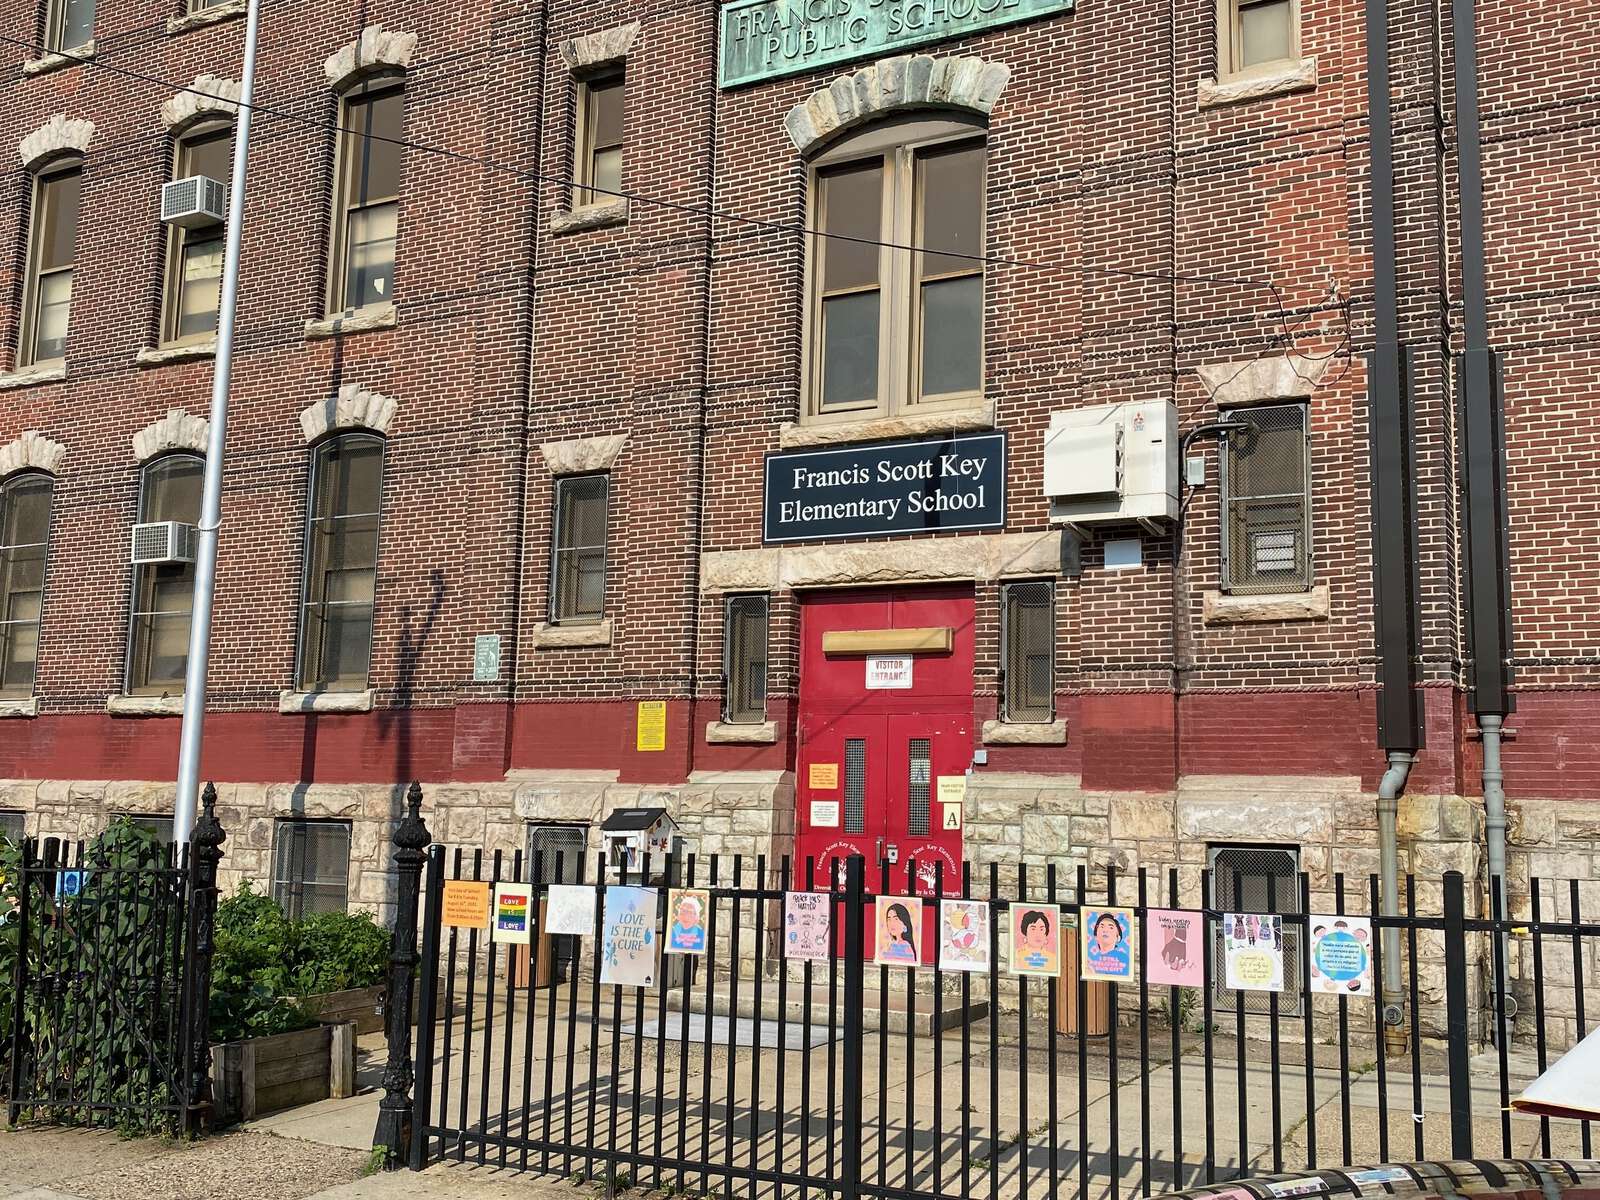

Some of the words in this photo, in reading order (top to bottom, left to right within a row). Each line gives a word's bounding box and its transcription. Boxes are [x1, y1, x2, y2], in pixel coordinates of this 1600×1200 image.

[735, 0, 852, 41] FRANCIS
[766, 15, 868, 64] PUBLIC
[792, 463, 870, 490] Francis
[877, 459, 933, 482] Scott
[939, 454, 988, 481] Key
[779, 498, 901, 523] Elementary
[907, 485, 986, 513] School
[875, 660, 904, 670] VISITOR
[871, 671, 907, 681] ENTRANCE
[946, 812, 958, 826] A
[938, 846, 957, 875] Elementary
[619, 913, 646, 926] LOVE
[610, 925, 620, 937] IS
[622, 926, 643, 939] THE
[617, 939, 645, 952] CURE
